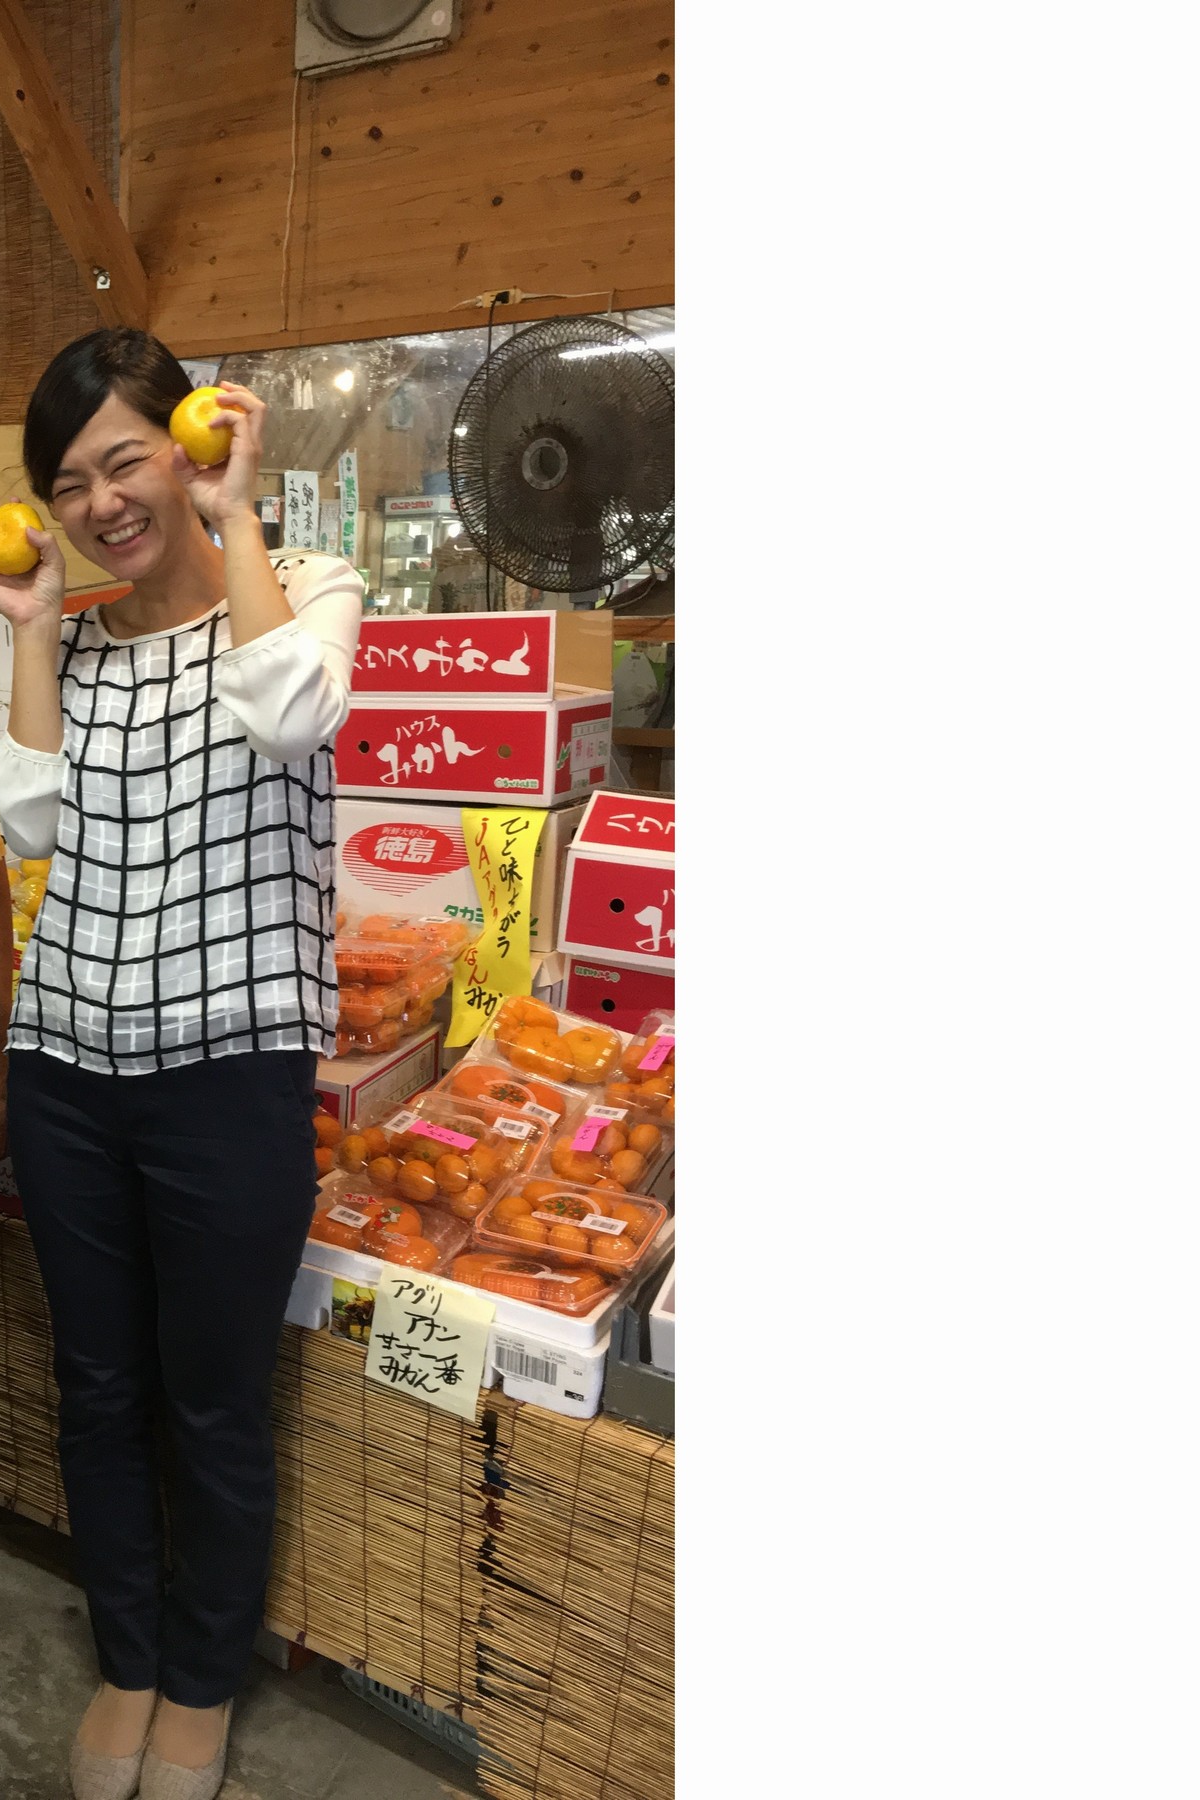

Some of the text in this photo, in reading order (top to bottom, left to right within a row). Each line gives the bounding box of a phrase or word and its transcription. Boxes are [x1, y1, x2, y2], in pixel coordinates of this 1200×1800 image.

[395, 714, 442, 743] ハウス
[376, 725, 488, 785] みかん
[373, 835, 438, 864] 徳島
[390, 1279, 444, 1316] アグリ
[403, 1310, 461, 1343] アナン
[377, 1355, 440, 1394] みかん
